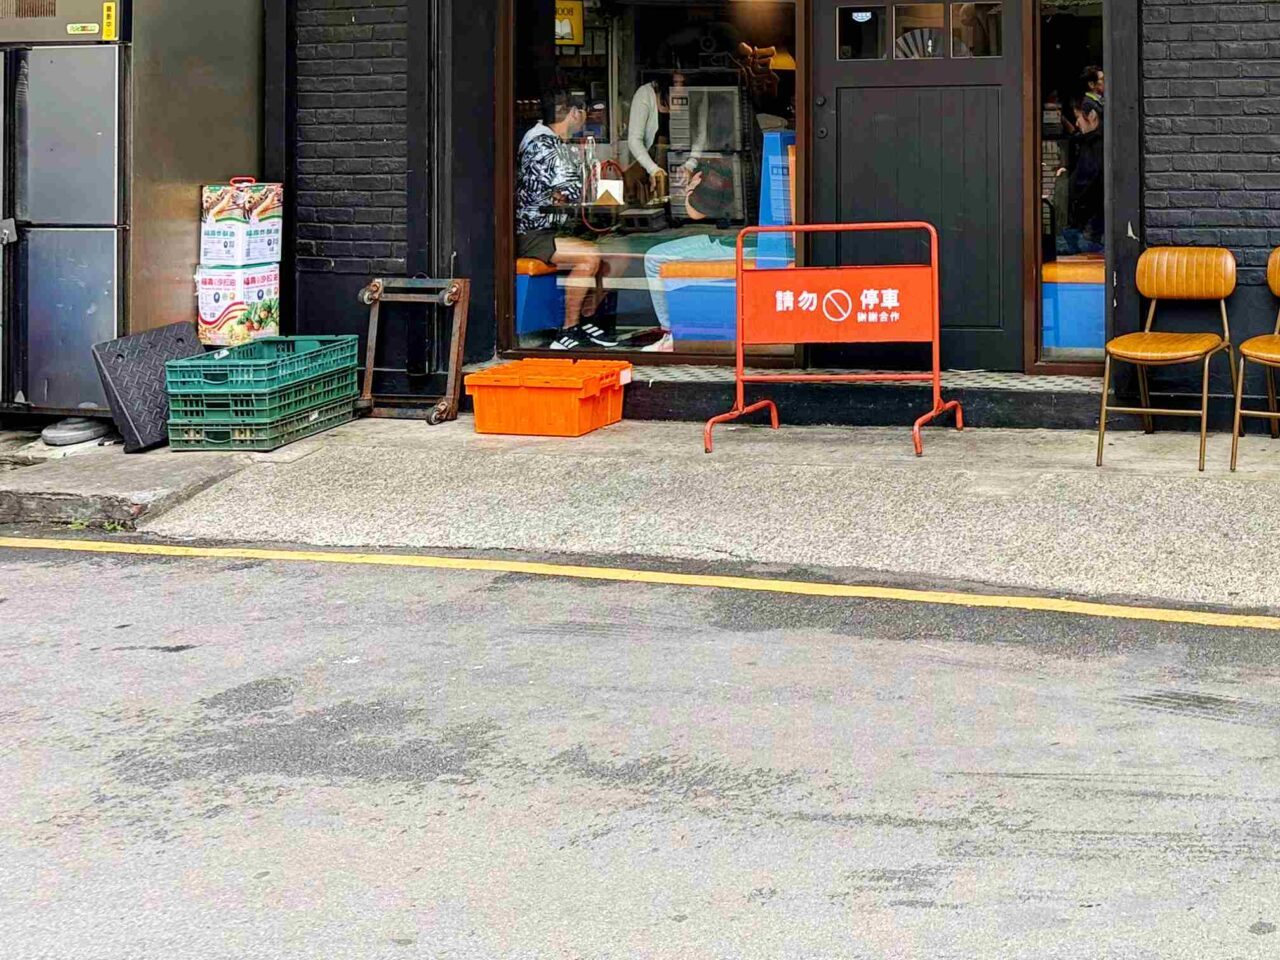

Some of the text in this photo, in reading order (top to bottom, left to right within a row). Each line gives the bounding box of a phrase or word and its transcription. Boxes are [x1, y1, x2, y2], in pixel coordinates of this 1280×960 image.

[775, 288, 900, 312] 請勿 停車
[857, 312, 900, 323] 謝謝合作
